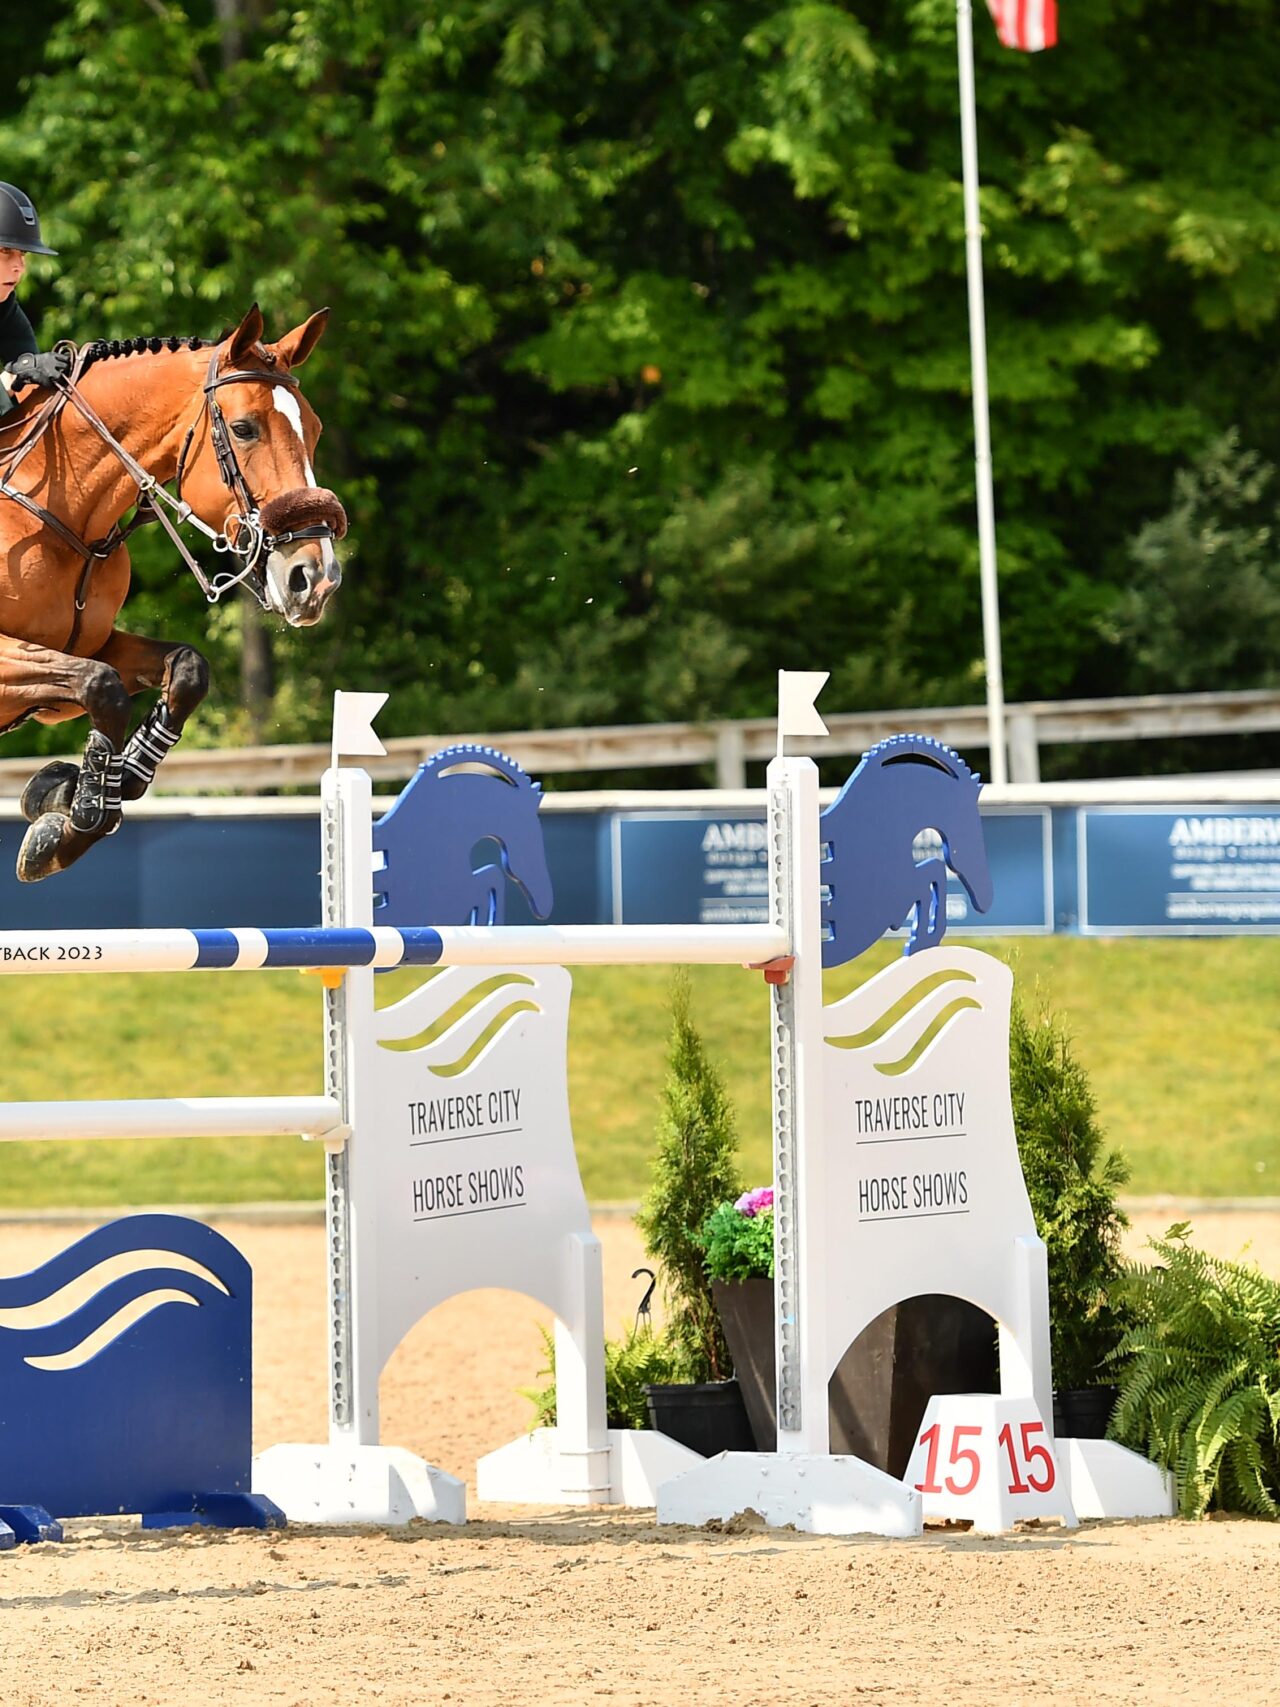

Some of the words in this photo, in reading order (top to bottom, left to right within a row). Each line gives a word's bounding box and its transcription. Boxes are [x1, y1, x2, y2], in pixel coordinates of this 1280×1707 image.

[408, 1094, 484, 1135] TRAVERSE
[489, 1089, 520, 1123] CITY
[855, 1096, 928, 1132] TRAVERSE
[934, 1093, 964, 1126] CITY
[413, 1174, 464, 1213] HORSE
[468, 1166, 524, 1204] SHOWS
[859, 1177, 908, 1212] HORSE
[913, 1172, 967, 1207] SHOWS
[915, 1424, 982, 1495] 15
[998, 1421, 1055, 1494] 15
